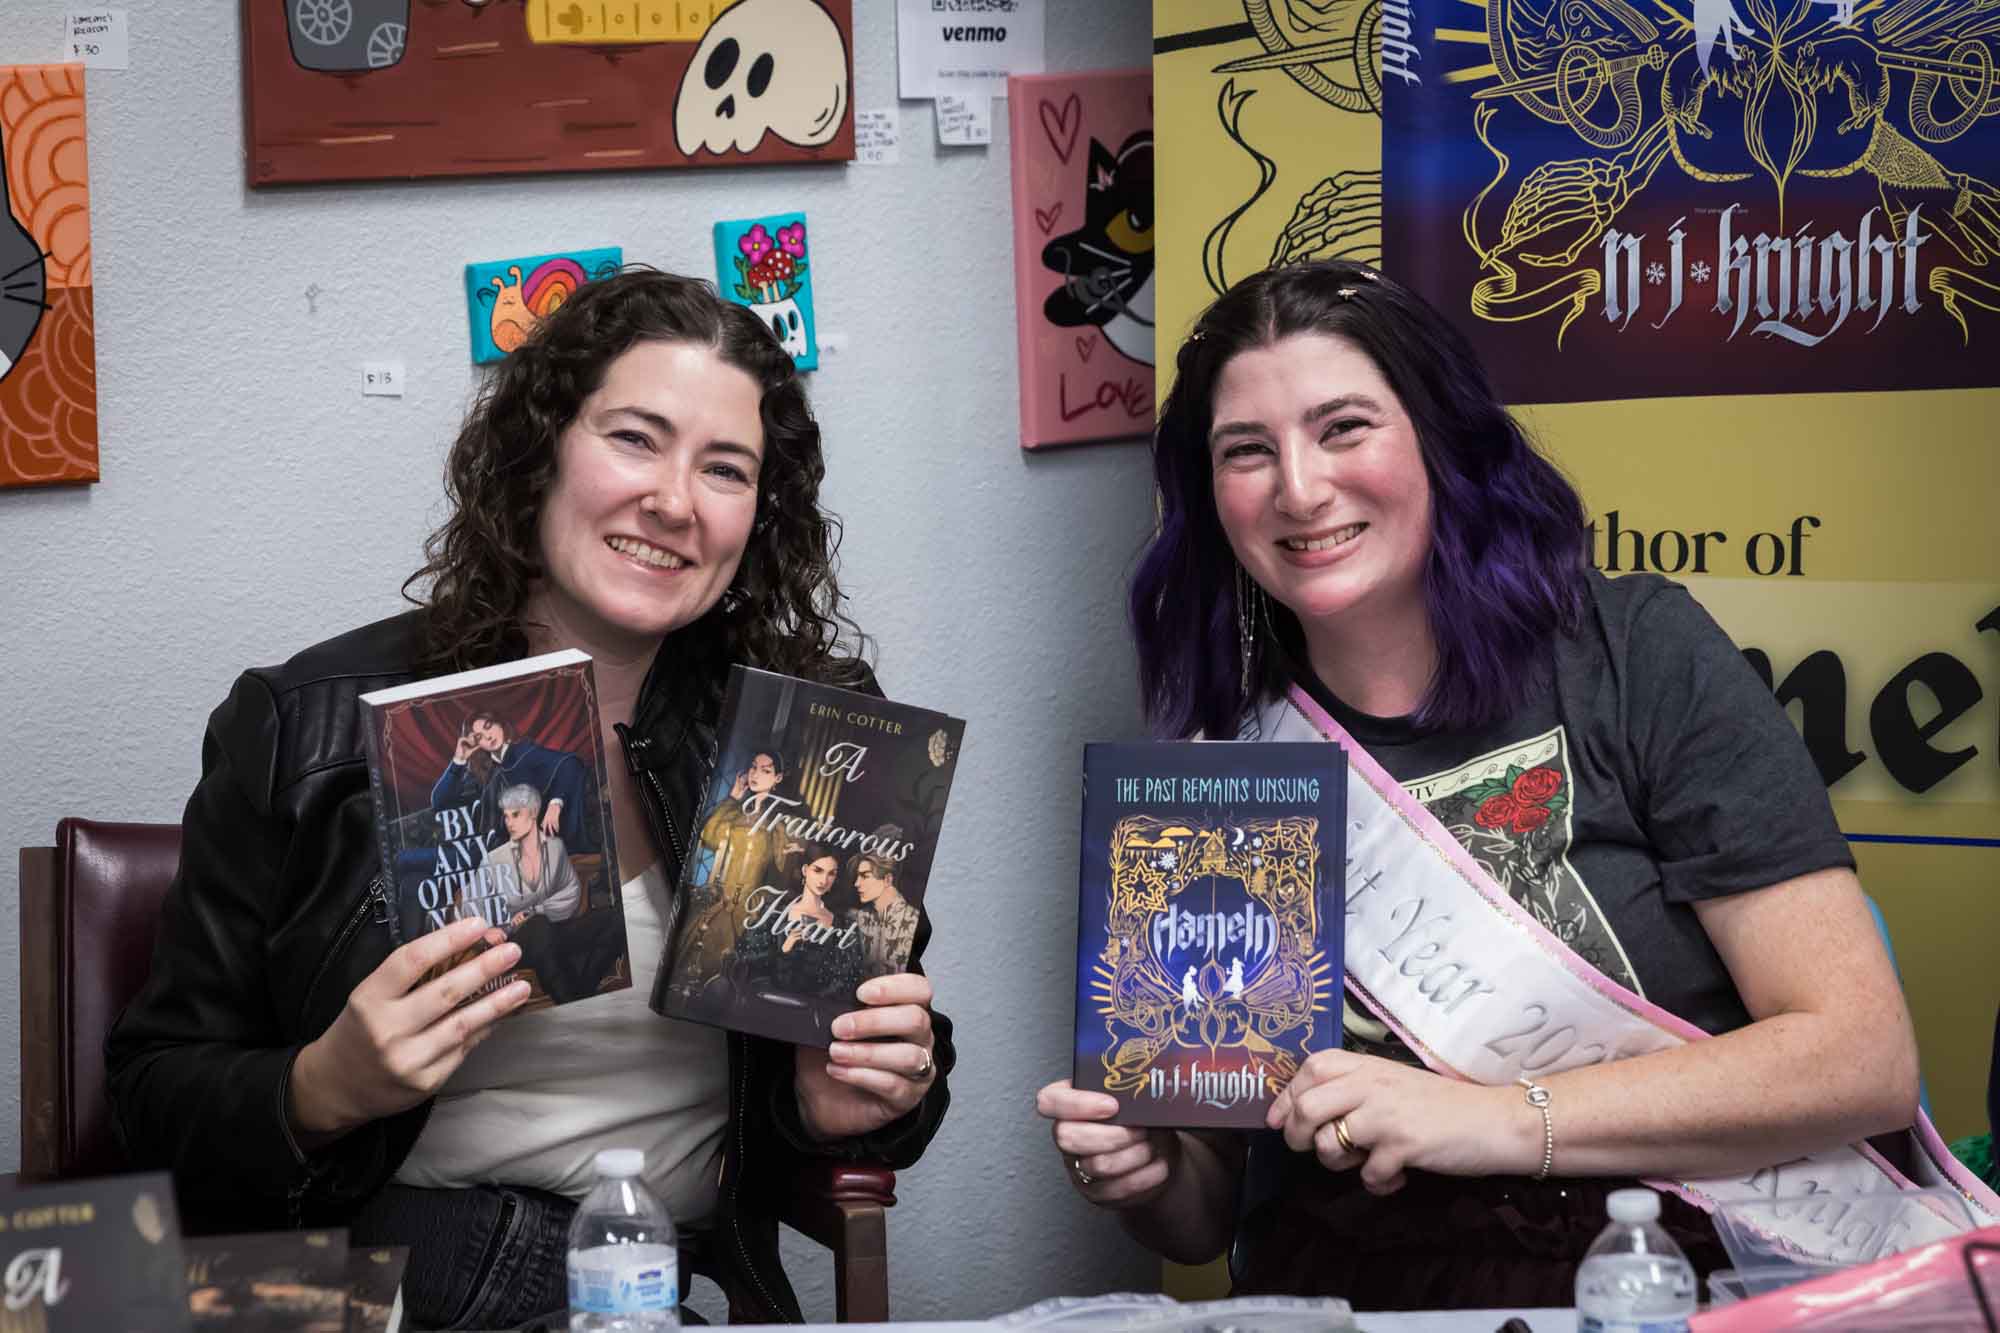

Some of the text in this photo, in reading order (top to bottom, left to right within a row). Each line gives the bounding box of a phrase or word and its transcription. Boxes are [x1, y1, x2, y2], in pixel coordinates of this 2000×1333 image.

[942, 26, 1007, 43] venmo
[1745, 515, 1822, 576] of
[809, 702, 903, 736] ERIN COTTER
[819, 742, 869, 784] A
[1115, 777, 1320, 806] THE PAST REMAINS UNSUNG
[434, 800, 481, 841] BY
[742, 793, 915, 863] Traitorous
[433, 829, 497, 877] ANY
[418, 863, 523, 911] OTHER
[743, 885, 858, 950] Heart
[1377, 898, 1496, 1015] Year
